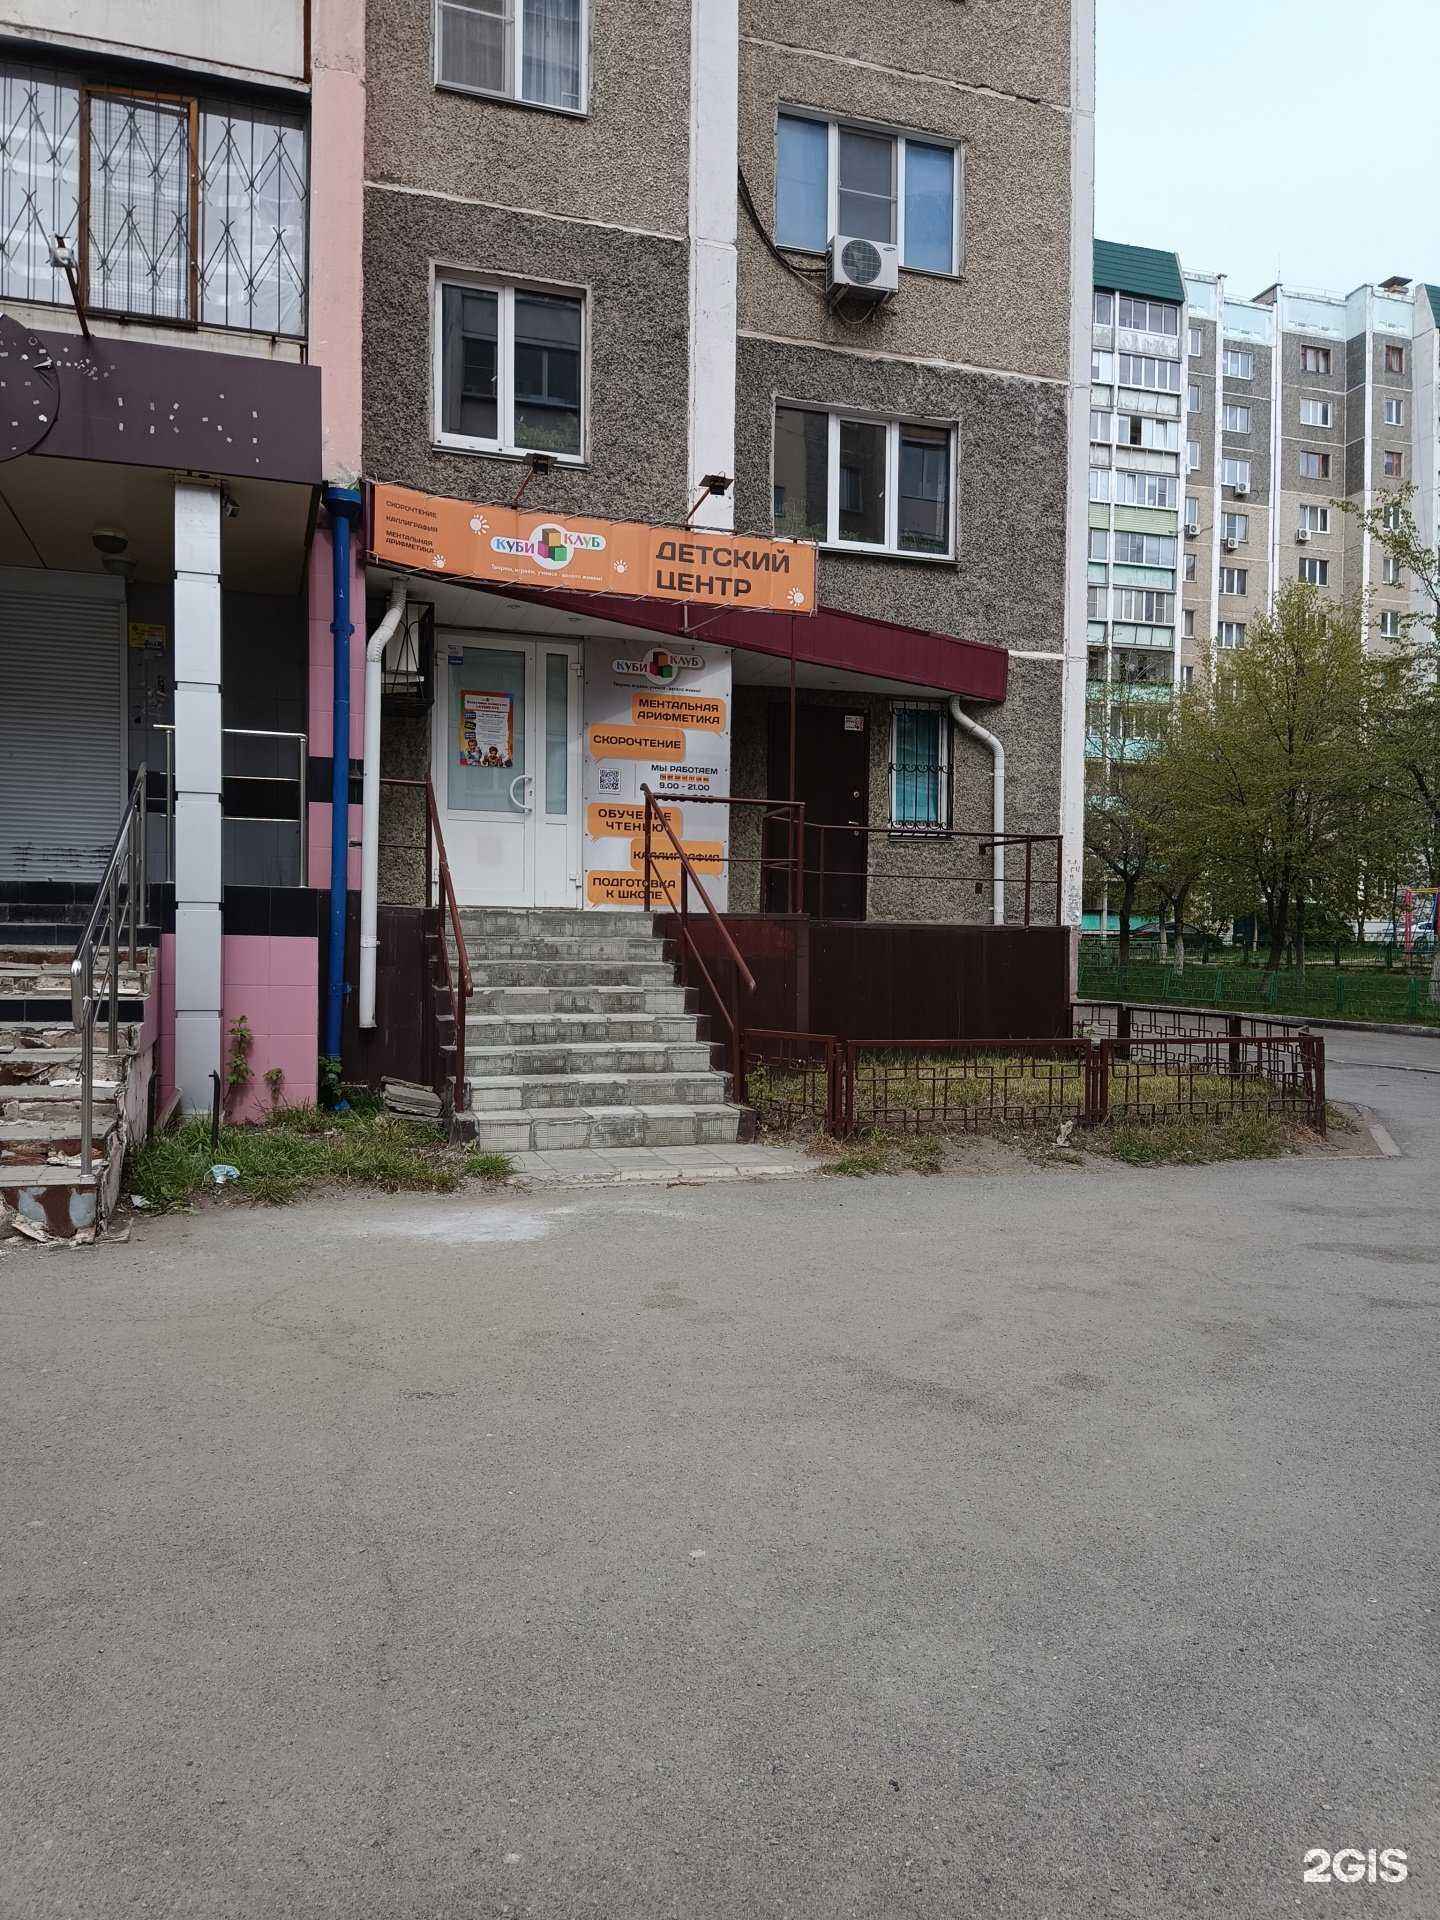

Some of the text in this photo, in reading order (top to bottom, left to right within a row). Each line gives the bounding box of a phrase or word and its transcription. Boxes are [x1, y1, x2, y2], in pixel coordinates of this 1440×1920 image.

[496, 532, 600, 554] КУБИ КЛУБ
[656, 541, 790, 574] ДЕТСКИЙ
[656, 570, 752, 597] ЦЕНТР
[616, 655, 699, 673] КУБИ КЛУБ
[638, 699, 719, 713] МЕНТАЛЬНАЯ
[637, 711, 720, 725] АРИФМЕТИКА
[593, 734, 681, 749] СКОРОЧТЕНИЕ
[651, 764, 718, 775] МЫ РАБОТАЕМ
[659, 782, 679, 790] 9.00
[687, 783, 710, 791] 21.00
[606, 821, 664, 832] ЧТЕНЮ
[606, 890, 614, 898] К
